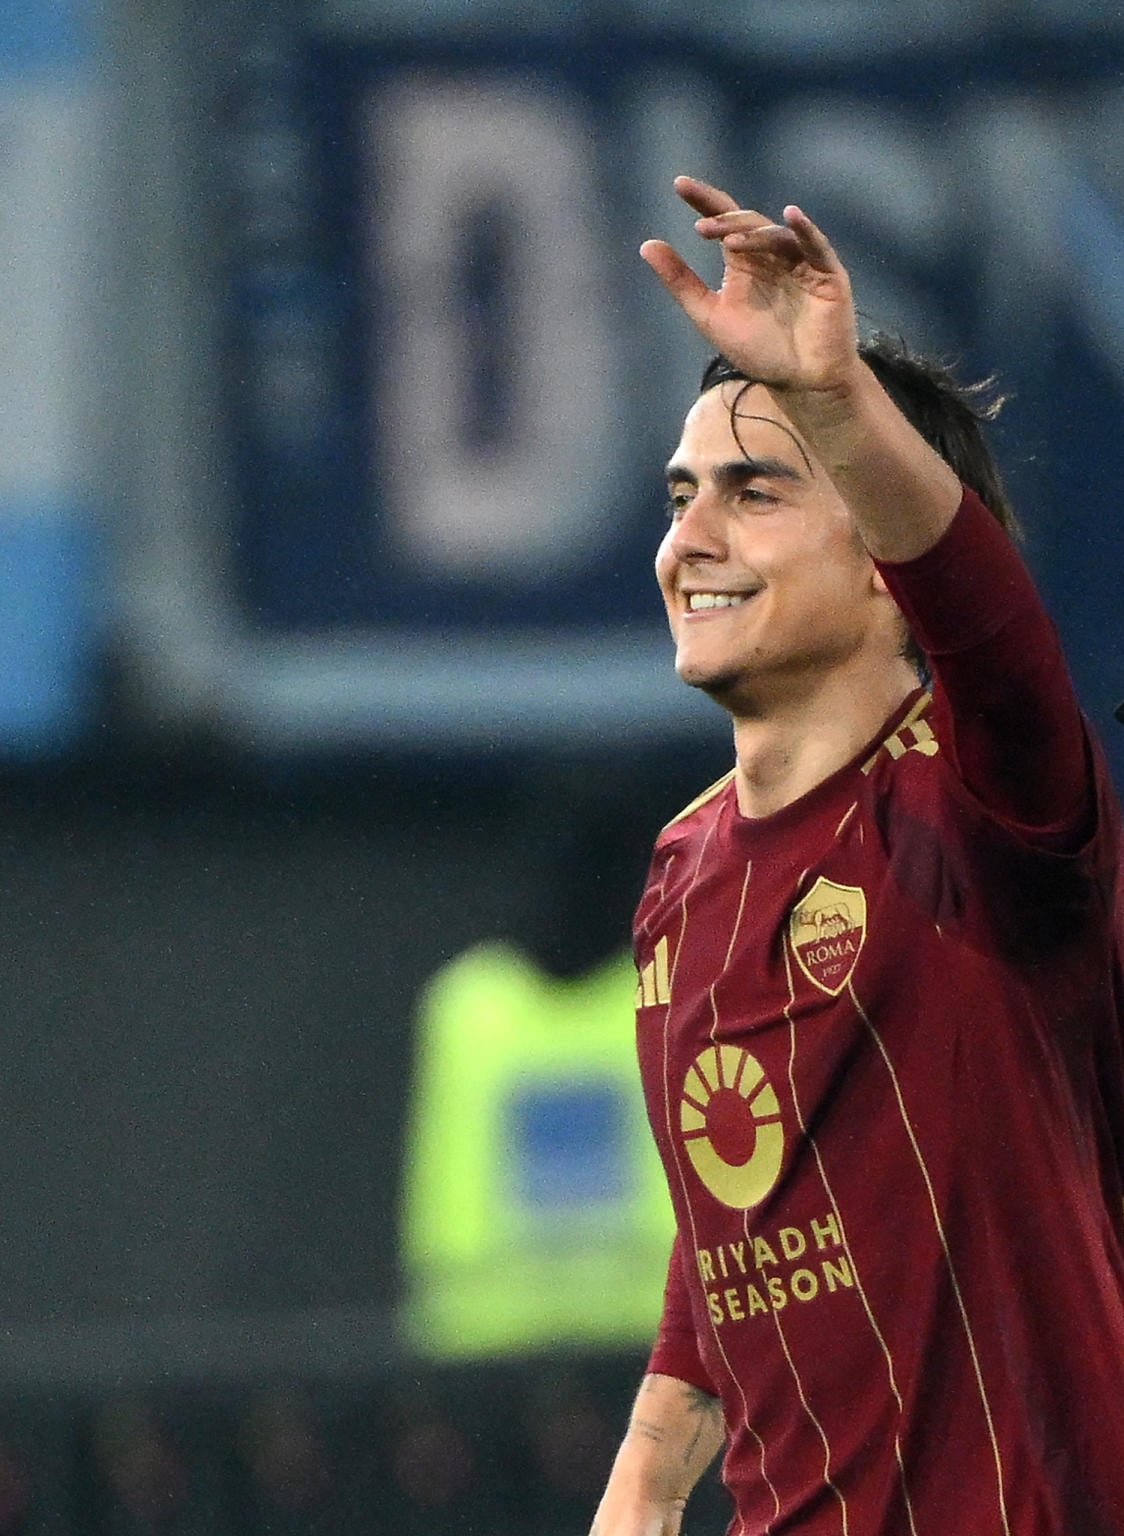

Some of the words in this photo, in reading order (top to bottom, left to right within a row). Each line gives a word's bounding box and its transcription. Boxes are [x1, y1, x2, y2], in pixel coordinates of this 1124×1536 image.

[806, 939, 856, 967] ROMA
[698, 1213, 841, 1282] RIYADH
[707, 1256, 853, 1325] SEASON
